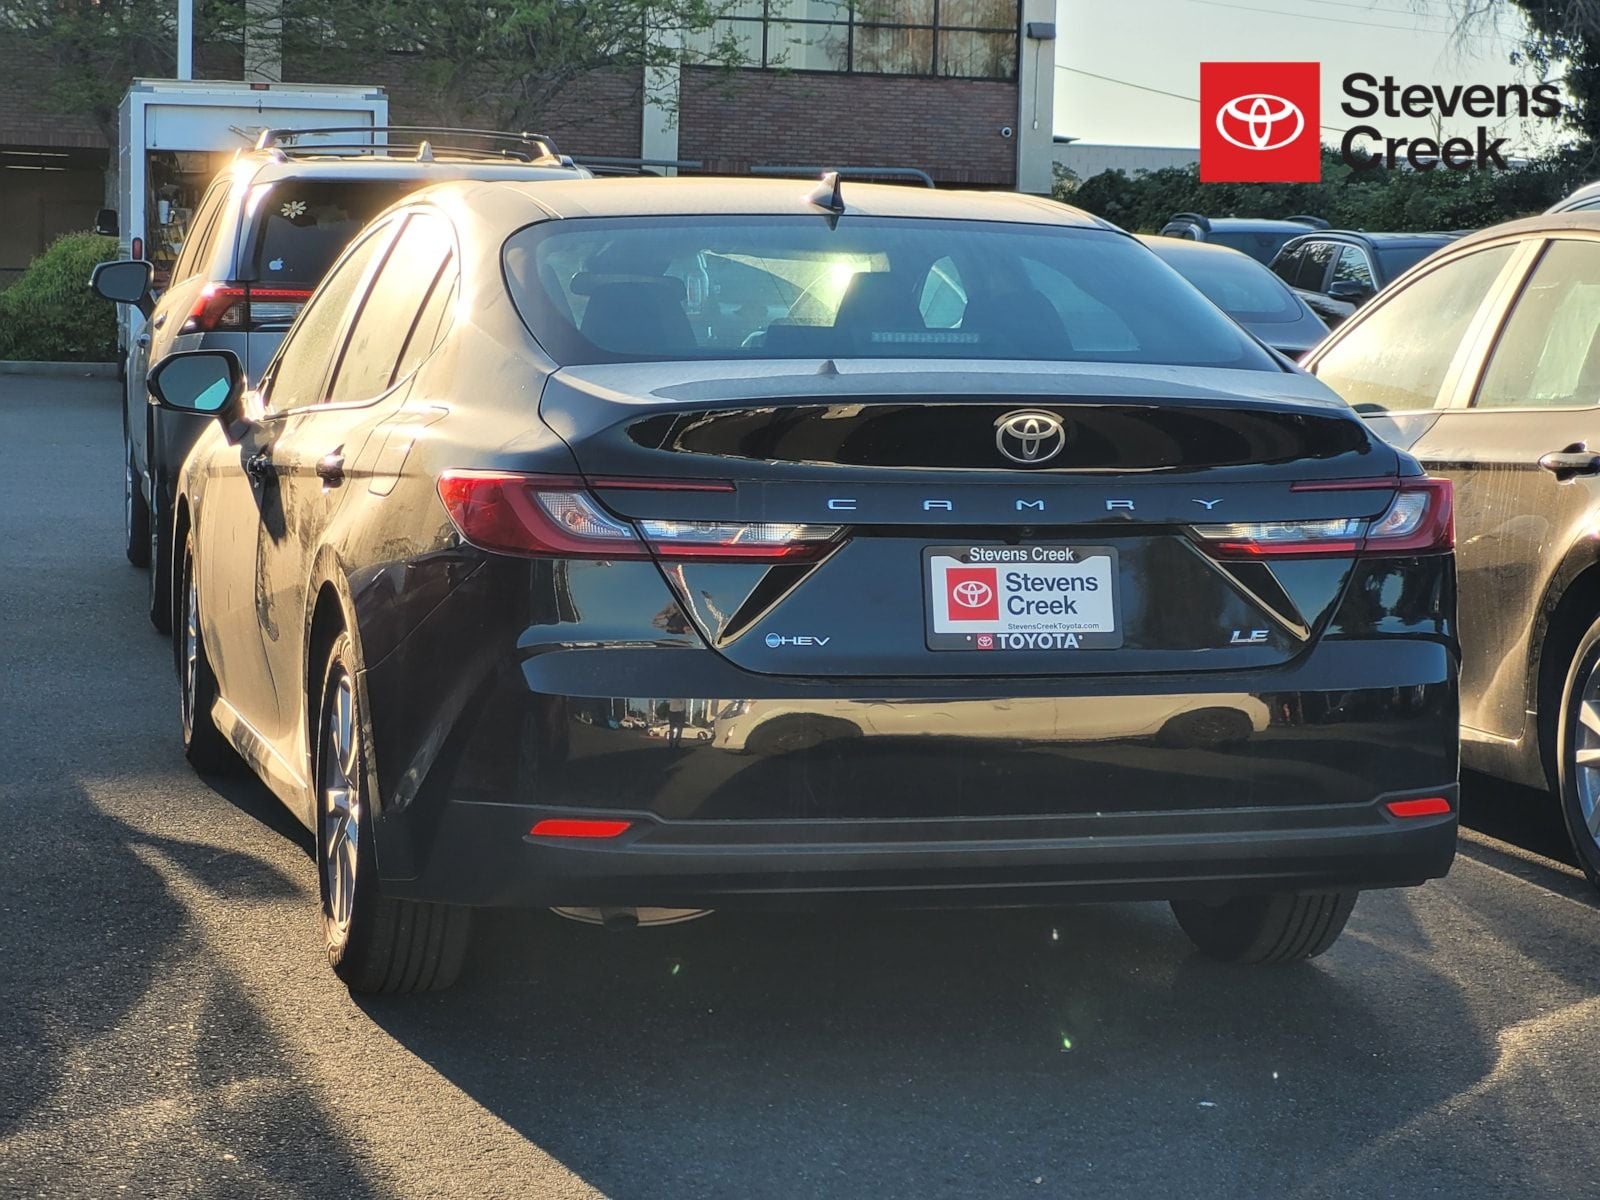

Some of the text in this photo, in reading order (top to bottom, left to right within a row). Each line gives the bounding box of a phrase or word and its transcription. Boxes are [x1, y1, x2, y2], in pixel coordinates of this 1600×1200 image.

[827, 498, 1224, 512] CAMRY
[969, 547, 1074, 562] Stevens Creek
[1005, 572, 1098, 592] Stevens
[1007, 595, 1078, 615] Creek
[1007, 622, 1100, 631] StevensCreekToyota.com
[996, 633, 1079, 649] TOYOTA
[1230, 630, 1270, 643] LE
